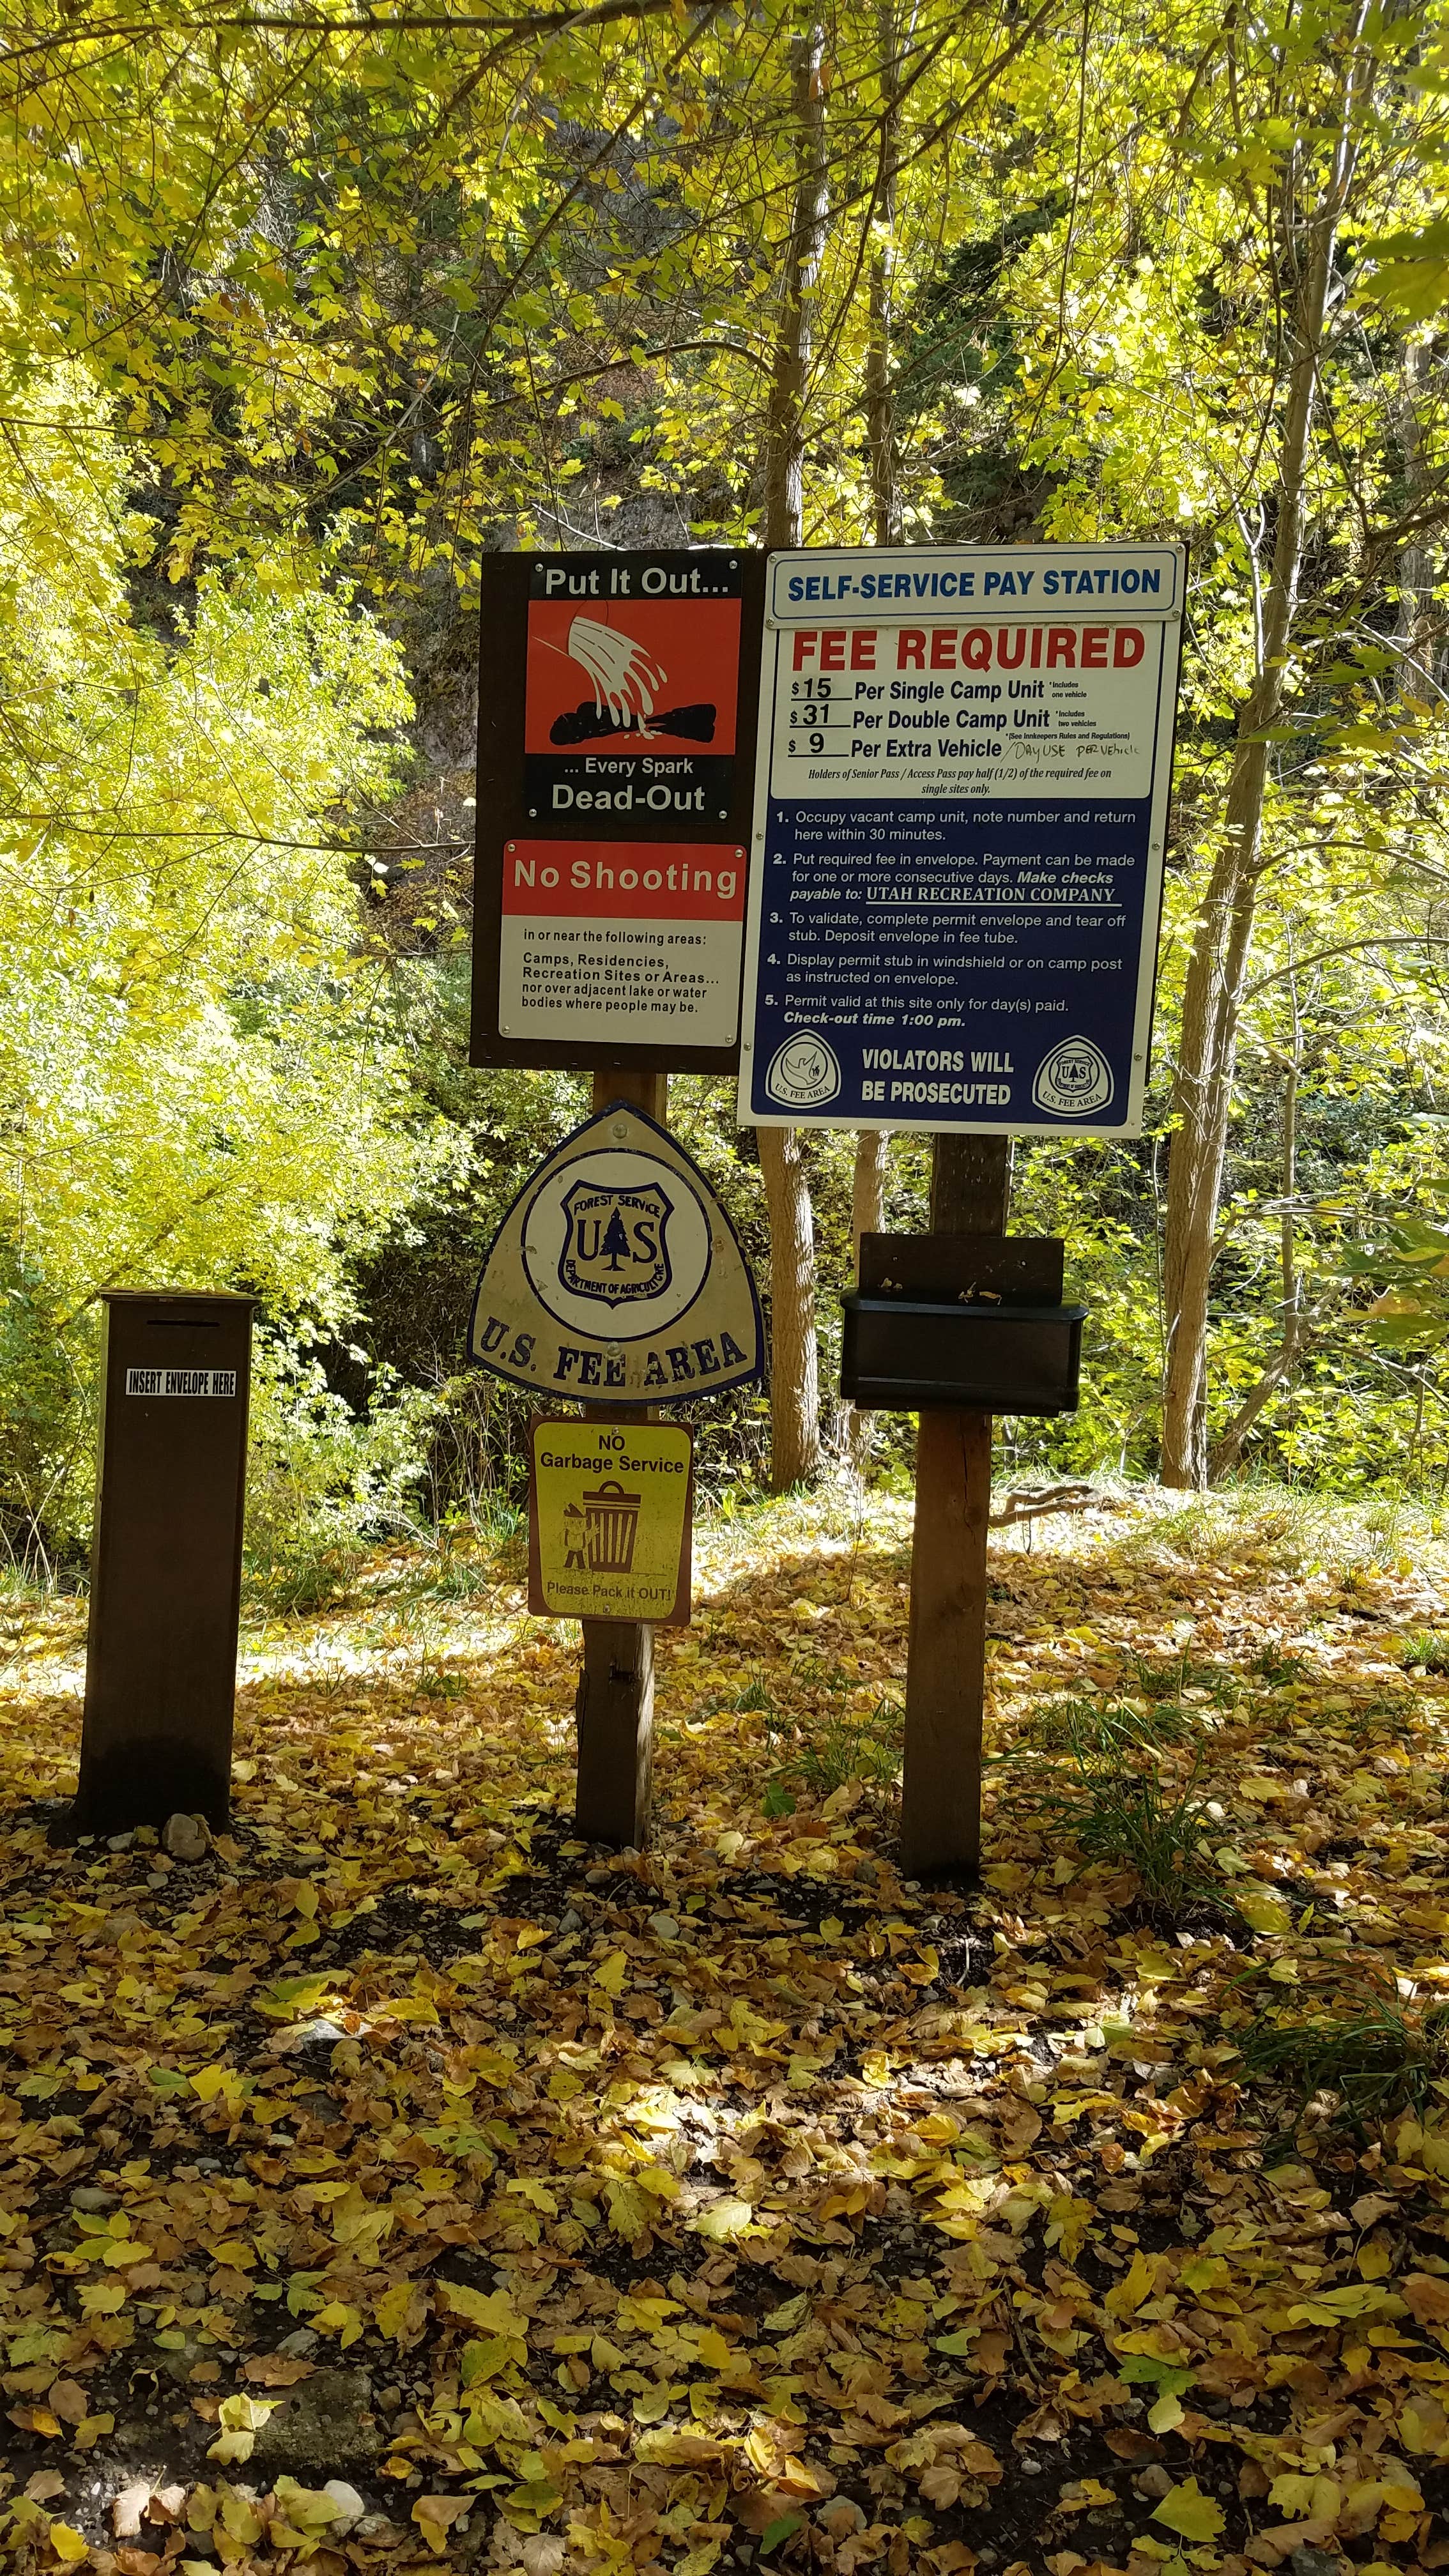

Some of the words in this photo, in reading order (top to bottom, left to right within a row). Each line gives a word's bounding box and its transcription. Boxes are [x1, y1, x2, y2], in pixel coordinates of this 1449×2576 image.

[546, 569, 599, 595] Put
[611, 568, 631, 594] It
[641, 567, 728, 594] Out...
[788, 572, 975, 602] SELF-SERVICE
[983, 571, 1035, 596] PAY
[1043, 569, 1161, 595] STATION
[792, 630, 877, 671] FEE
[896, 628, 1145, 671] REQUIRED
[804, 677, 832, 698] 15
[855, 682, 885, 700] Per
[889, 680, 944, 703] Single
[950, 680, 1002, 703] Camp
[1008, 680, 1045, 699] Unit
[802, 703, 829, 725] 31
[853, 710, 883, 729] Per
[888, 710, 950, 728] Double
[956, 709, 1008, 732] Camp
[1013, 709, 1050, 728] Unit
[809, 732, 824, 754] 9
[851, 739, 881, 758] Per
[886, 739, 931, 758] Extra
[937, 739, 1002, 757] Vehicle
[1043, 744, 1066, 758] USE
[1076, 744, 1100, 758] PER
[585, 757, 636, 778] Every
[641, 757, 693, 778] Spark
[552, 784, 705, 811] Dead-Out
[776, 811, 789, 823] 1.
[795, 811, 847, 825] Occupy
[850, 811, 894, 823] vacant
[898, 813, 935, 825] camp
[940, 811, 969, 824] unit,
[973, 811, 1003, 822] note
[1008, 810, 1061, 822] number
[1064, 810, 1090, 823] and
[1094, 811, 1136, 823] return
[795, 828, 823, 840] here
[827, 828, 865, 840] within
[869, 828, 885, 840] 30
[889, 828, 946, 840] minutes.
[772, 853, 786, 864] 2.
[793, 853, 815, 865] Put
[818, 853, 872, 868] required
[875, 853, 896, 865] fee
[900, 853, 911, 865] in
[915, 853, 978, 868] envelope.
[983, 853, 1041, 868] Payment
[1045, 856, 1070, 866] can
[1074, 854, 1092, 866] be
[1096, 854, 1135, 866] made
[514, 859, 560, 888] No
[570, 861, 737, 900] Shooting
[790, 887, 841, 902] payable
[845, 888, 862, 900] to:
[866, 887, 913, 901] UTAH
[917, 887, 1026, 901] RECREATION
[1030, 887, 1116, 903] COMPANY
[769, 912, 783, 923] 3.
[789, 912, 804, 924] To
[808, 912, 862, 926] validate,
[867, 913, 929, 927] complete
[932, 914, 976, 928] permit
[979, 914, 1041, 929] envelope
[1045, 914, 1071, 926] and
[1075, 915, 1104, 926] tear
[1107, 915, 1126, 927] off
[524, 928, 535, 940] in
[538, 931, 551, 940] or
[553, 932, 581, 942] near
[583, 930, 602, 942] the
[605, 931, 664, 947] following
[667, 935, 706, 945] areas:
[523, 952, 574, 967] Camps,
[578, 954, 668, 970] Residencies,
[523, 967, 600, 981] Recreation
[604, 969, 640, 981] Sites
[645, 973, 660, 982] or
[662, 971, 719, 984] Areas...
[522, 984, 542, 997] nor
[545, 985, 571, 994] over
[574, 984, 626, 998] adjacent
[629, 985, 654, 997] lake
[657, 988, 670, 997] or
[673, 987, 707, 999] water
[522, 995, 562, 1008] bodies
[565, 997, 602, 1009] where
[605, 999, 648, 1013] people
[651, 1002, 677, 1015] may
[679, 1000, 698, 1013] be.
[765, 994, 778, 1006] 5.
[785, 994, 827, 1007] Permit
[831, 995, 861, 1007] valid
[864, 996, 878, 1008] at
[881, 996, 905, 1008] this
[908, 997, 933, 1009] site
[937, 997, 965, 1012] only
[968, 998, 988, 1010] for
[991, 998, 1031, 1013] day(s)
[1035, 999, 1068, 1013] paid.
[784, 1011, 859, 1024] Check-out
[862, 1013, 895, 1025] time
[901, 1014, 934, 1026] 1:00
[937, 1017, 965, 1029] pm.
[862, 1048, 964, 1072] VIOLATORS
[970, 1052, 1014, 1073] WILL
[775, 1083, 788, 1096] U.S.
[790, 1090, 806, 1099] FEE
[807, 1085, 831, 1099] AREA
[861, 1080, 885, 1101] BE
[891, 1081, 1011, 1105] PROSECUTED
[1043, 1091, 1056, 1104] U.S.
[1057, 1098, 1075, 1107] FEE
[1077, 1093, 1103, 1107] AREA
[574, 1195, 614, 1216] FOREST
[617, 1195, 661, 1219] SERVICE
[565, 1259, 607, 1294] DEPARTMENT
[608, 1283, 619, 1294] OF
[480, 1315, 537, 1372] U.S.
[553, 1345, 627, 1387] FEE
[643, 1331, 748, 1386] AREA
[128, 1370, 162, 1393] INSERT
[165, 1371, 209, 1395] ENVELOPE
[212, 1372, 234, 1395] HERE
[599, 1434, 625, 1451] NO
[540, 1452, 613, 1473] Garbage
[619, 1455, 684, 1473] Service
[546, 1582, 589, 1595] Please
[593, 1584, 623, 1598] Pack
[626, 1587, 635, 1598] it
[638, 1588, 671, 1601] OUT!
